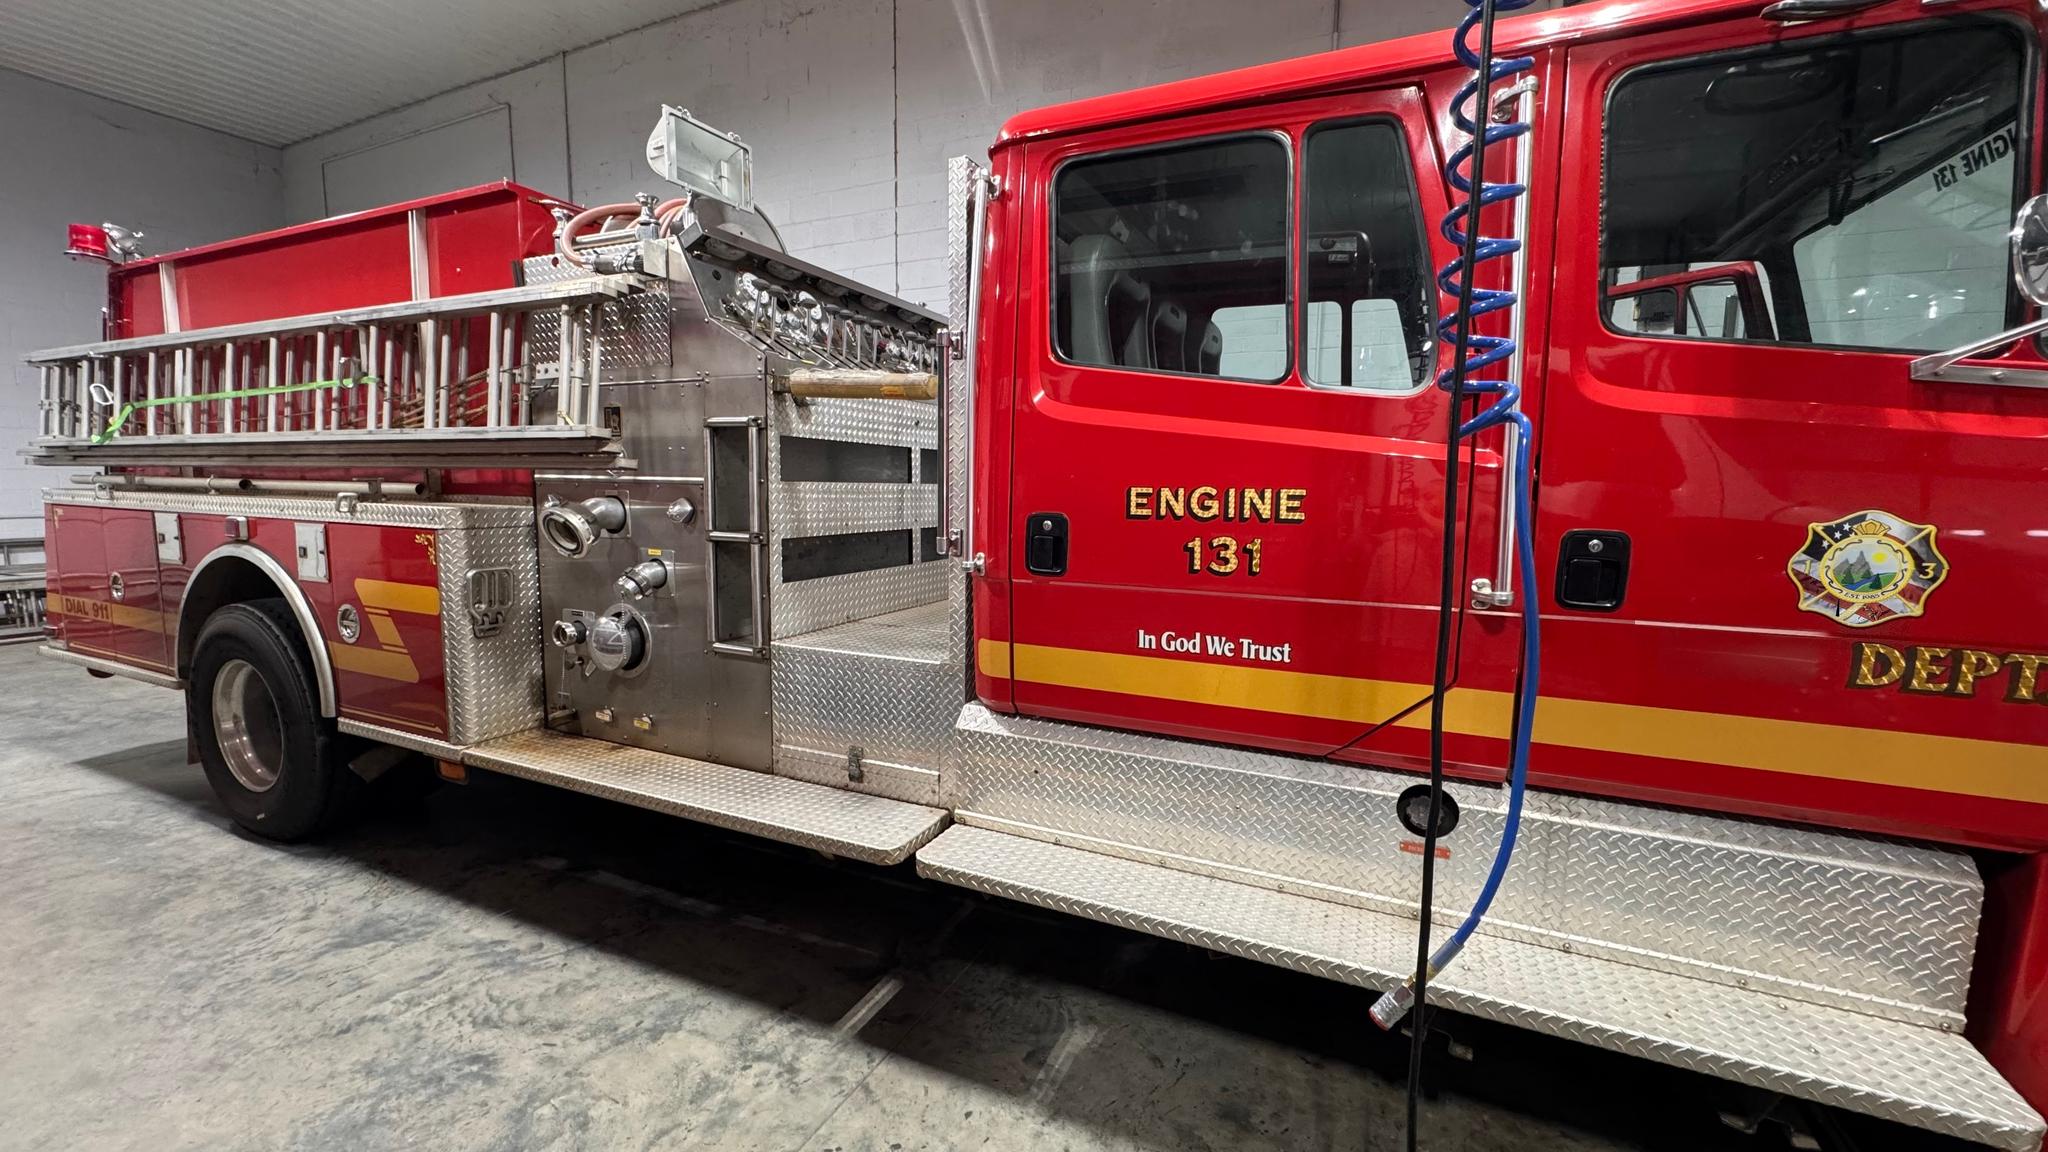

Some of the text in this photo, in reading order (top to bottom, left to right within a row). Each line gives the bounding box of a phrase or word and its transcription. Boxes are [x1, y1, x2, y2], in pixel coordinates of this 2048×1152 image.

[1127, 486, 1307, 524] ENGINE
[1184, 536, 1263, 576] 131
[1918, 562, 1937, 580] 3
[65, 598, 109, 620] DIAL 911
[1138, 629, 1292, 663] In God We Trust
[1848, 642, 2048, 705] DEPT
